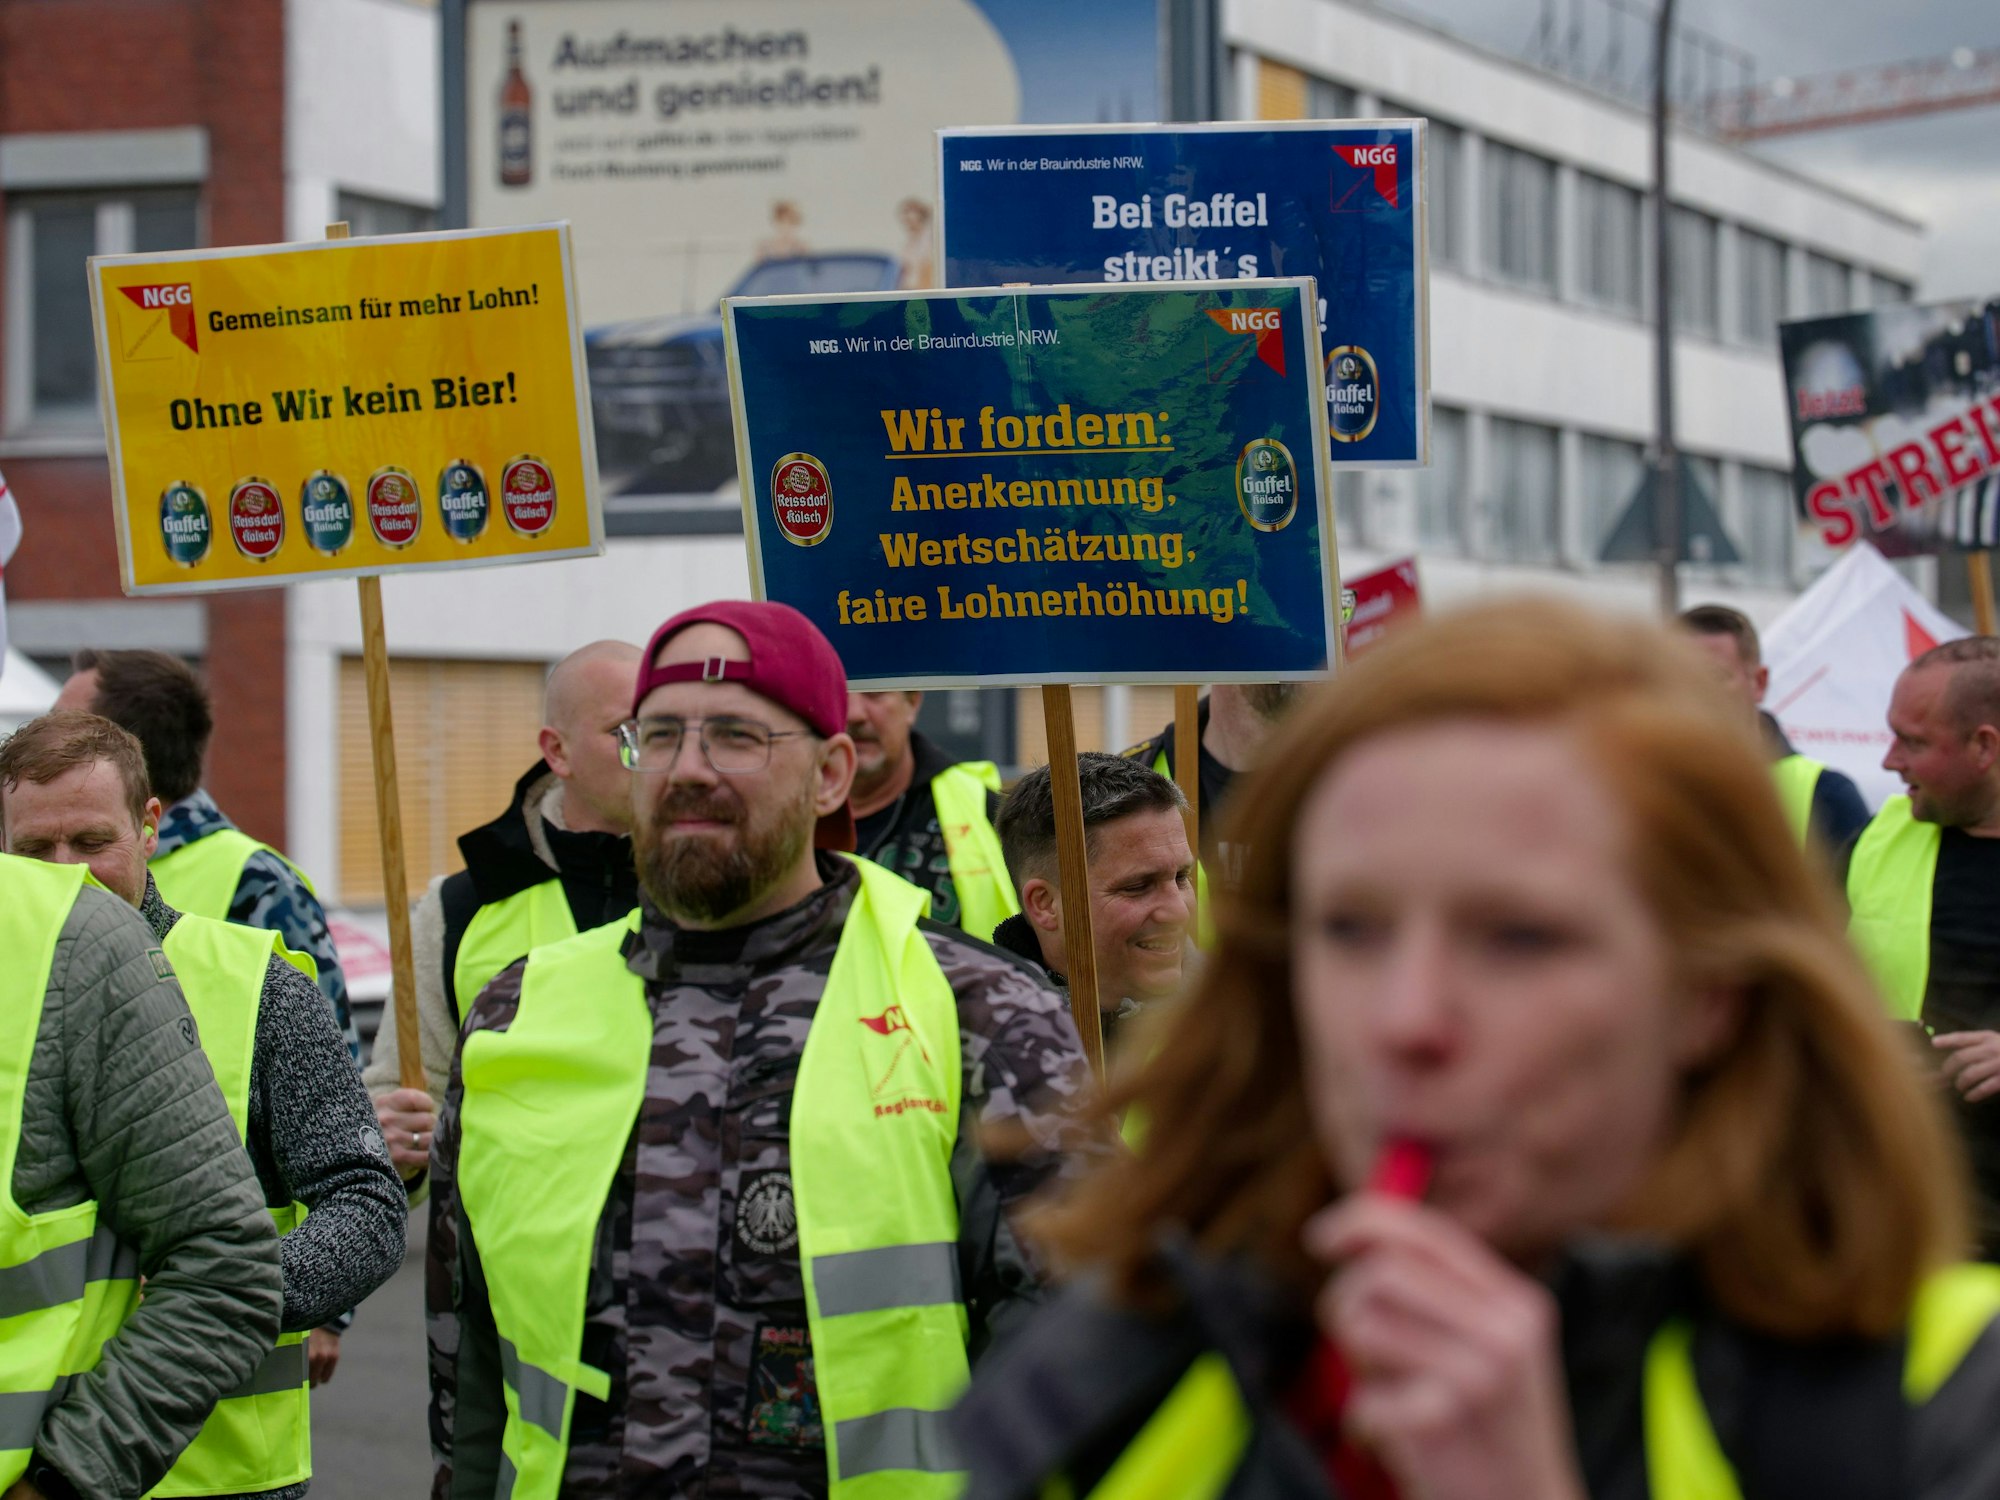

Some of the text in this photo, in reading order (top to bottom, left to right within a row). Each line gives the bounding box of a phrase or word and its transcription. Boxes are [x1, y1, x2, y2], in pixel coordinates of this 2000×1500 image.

[554, 27, 807, 70] Aufmachen
[554, 67, 881, 121] und genießen!
[960, 156, 1144, 172] NGG. Wir in der Brauindustrie NRW.
[1354, 148, 1396, 165] NGG
[1092, 192, 1268, 229] Bei Gaffel
[143, 285, 191, 307] NGG
[209, 284, 539, 332] Gemeinsam für mehr Lohn!
[1231, 310, 1281, 331] NGG
[809, 329, 1060, 354] NGG. Wir in der Brauindustrie NRW.
[170, 372, 517, 431] Ohne Wir kein Bier!
[1325, 384, 1373, 403] Gaffel
[881, 404, 1172, 452] Wir fordern:
[1807, 392, 2000, 547] STREI
[890, 472, 1177, 514] Anerkennung,
[1243, 474, 1292, 495] Gaffel
[441, 492, 486, 510] Gaffel
[777, 492, 827, 508] Reissdorf
[1253, 494, 1284, 505] Kölsch
[304, 502, 350, 522] Gaffel
[786, 509, 822, 525] Kölsch
[163, 514, 208, 533] Gaffel
[880, 528, 1197, 569] Wertschätzung,
[838, 578, 1248, 625] faire Lohnerhöhung!
